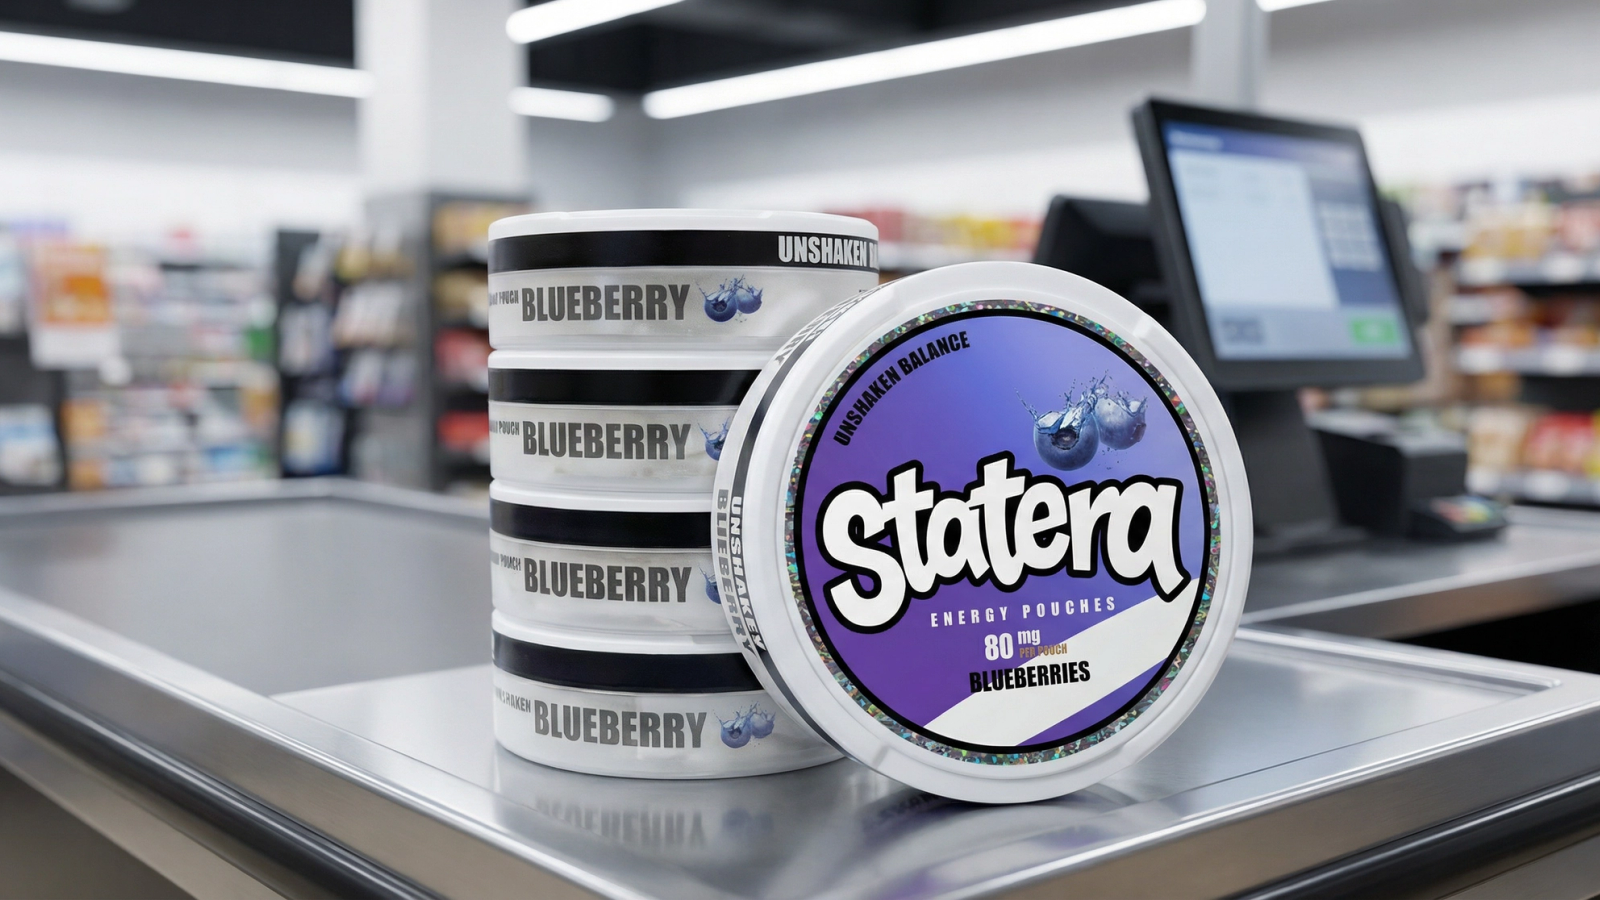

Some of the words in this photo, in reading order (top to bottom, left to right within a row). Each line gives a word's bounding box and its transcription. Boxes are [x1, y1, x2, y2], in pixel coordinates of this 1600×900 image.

[778, 235, 867, 267] UNSHAKEN
[521, 284, 690, 322] BLUEBERRY
[833, 368, 901, 447] UNSHAKEN
[897, 331, 971, 376] BALANCE
[523, 420, 691, 460] BLUEBERRY
[816, 451, 1191, 635] Statera
[524, 557, 692, 602] BLUEBERRY
[930, 606, 1008, 627] ENERGY
[1022, 596, 1115, 619] POUCHES
[984, 632, 1014, 661] 80
[1017, 629, 1041, 646] mg
[1038, 643, 1068, 657] POUCH
[969, 660, 1091, 693] BLUEBERRIES
[534, 700, 707, 748] BLUEBERRY
